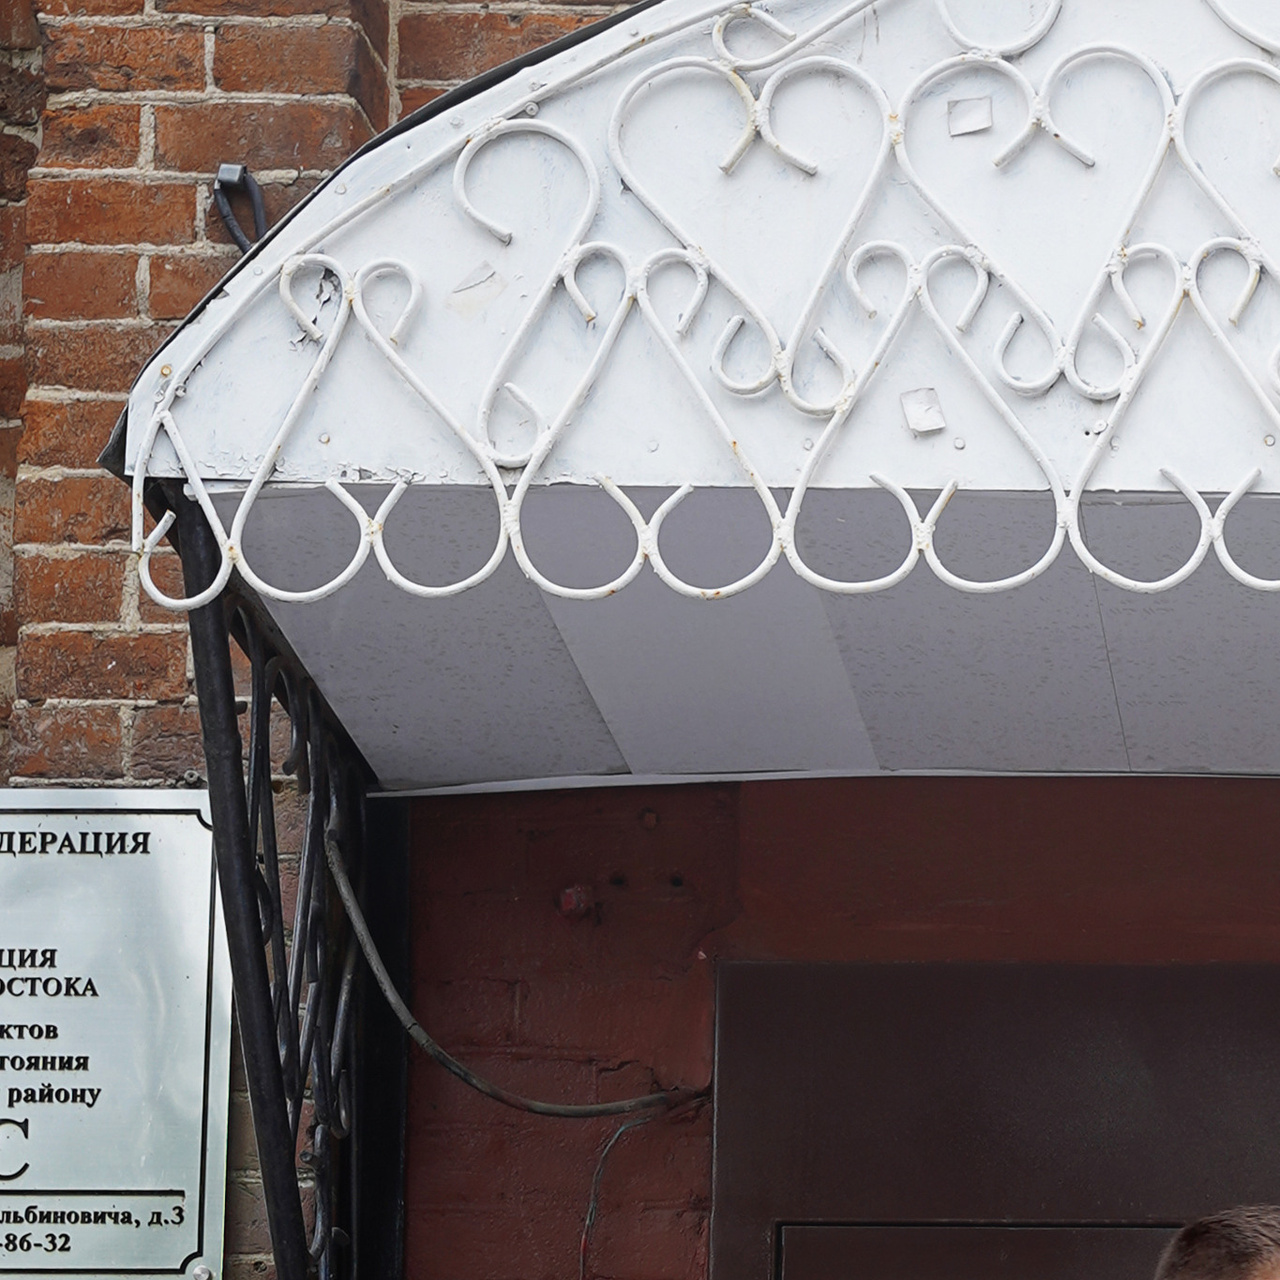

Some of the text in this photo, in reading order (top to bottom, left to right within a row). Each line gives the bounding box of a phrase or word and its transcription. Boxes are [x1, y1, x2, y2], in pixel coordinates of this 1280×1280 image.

[0, 976, 99, 997] СТОКА
[7, 1082, 102, 1108] району
[147, 1205, 185, 1226] д.3
